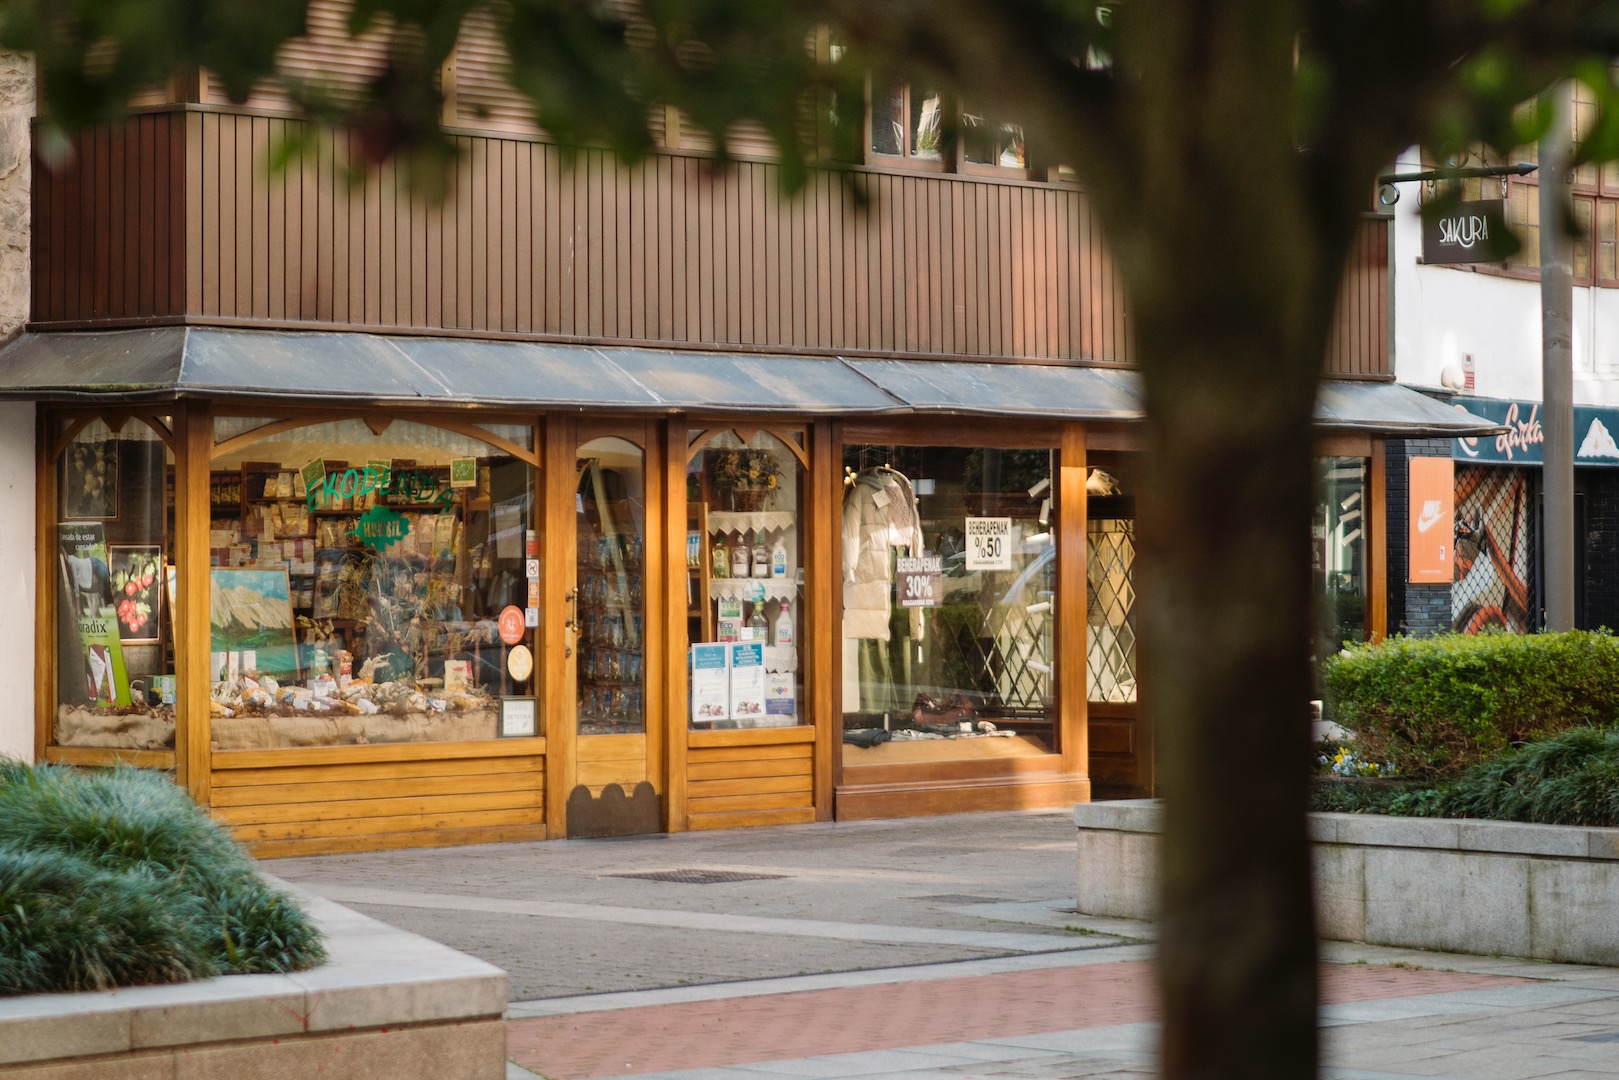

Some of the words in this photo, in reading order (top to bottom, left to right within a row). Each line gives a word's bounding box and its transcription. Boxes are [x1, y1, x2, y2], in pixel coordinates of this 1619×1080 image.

[1439, 215, 1489, 248] SAKURA
[306, 467, 454, 513] EKODENDA
[968, 520, 1009, 536] BEHERAPENAK
[974, 537, 1002, 558] %50
[897, 557, 941, 572] BEHERAPENAK
[906, 575, 933, 597] 30%
[79, 620, 107, 633] oradix
